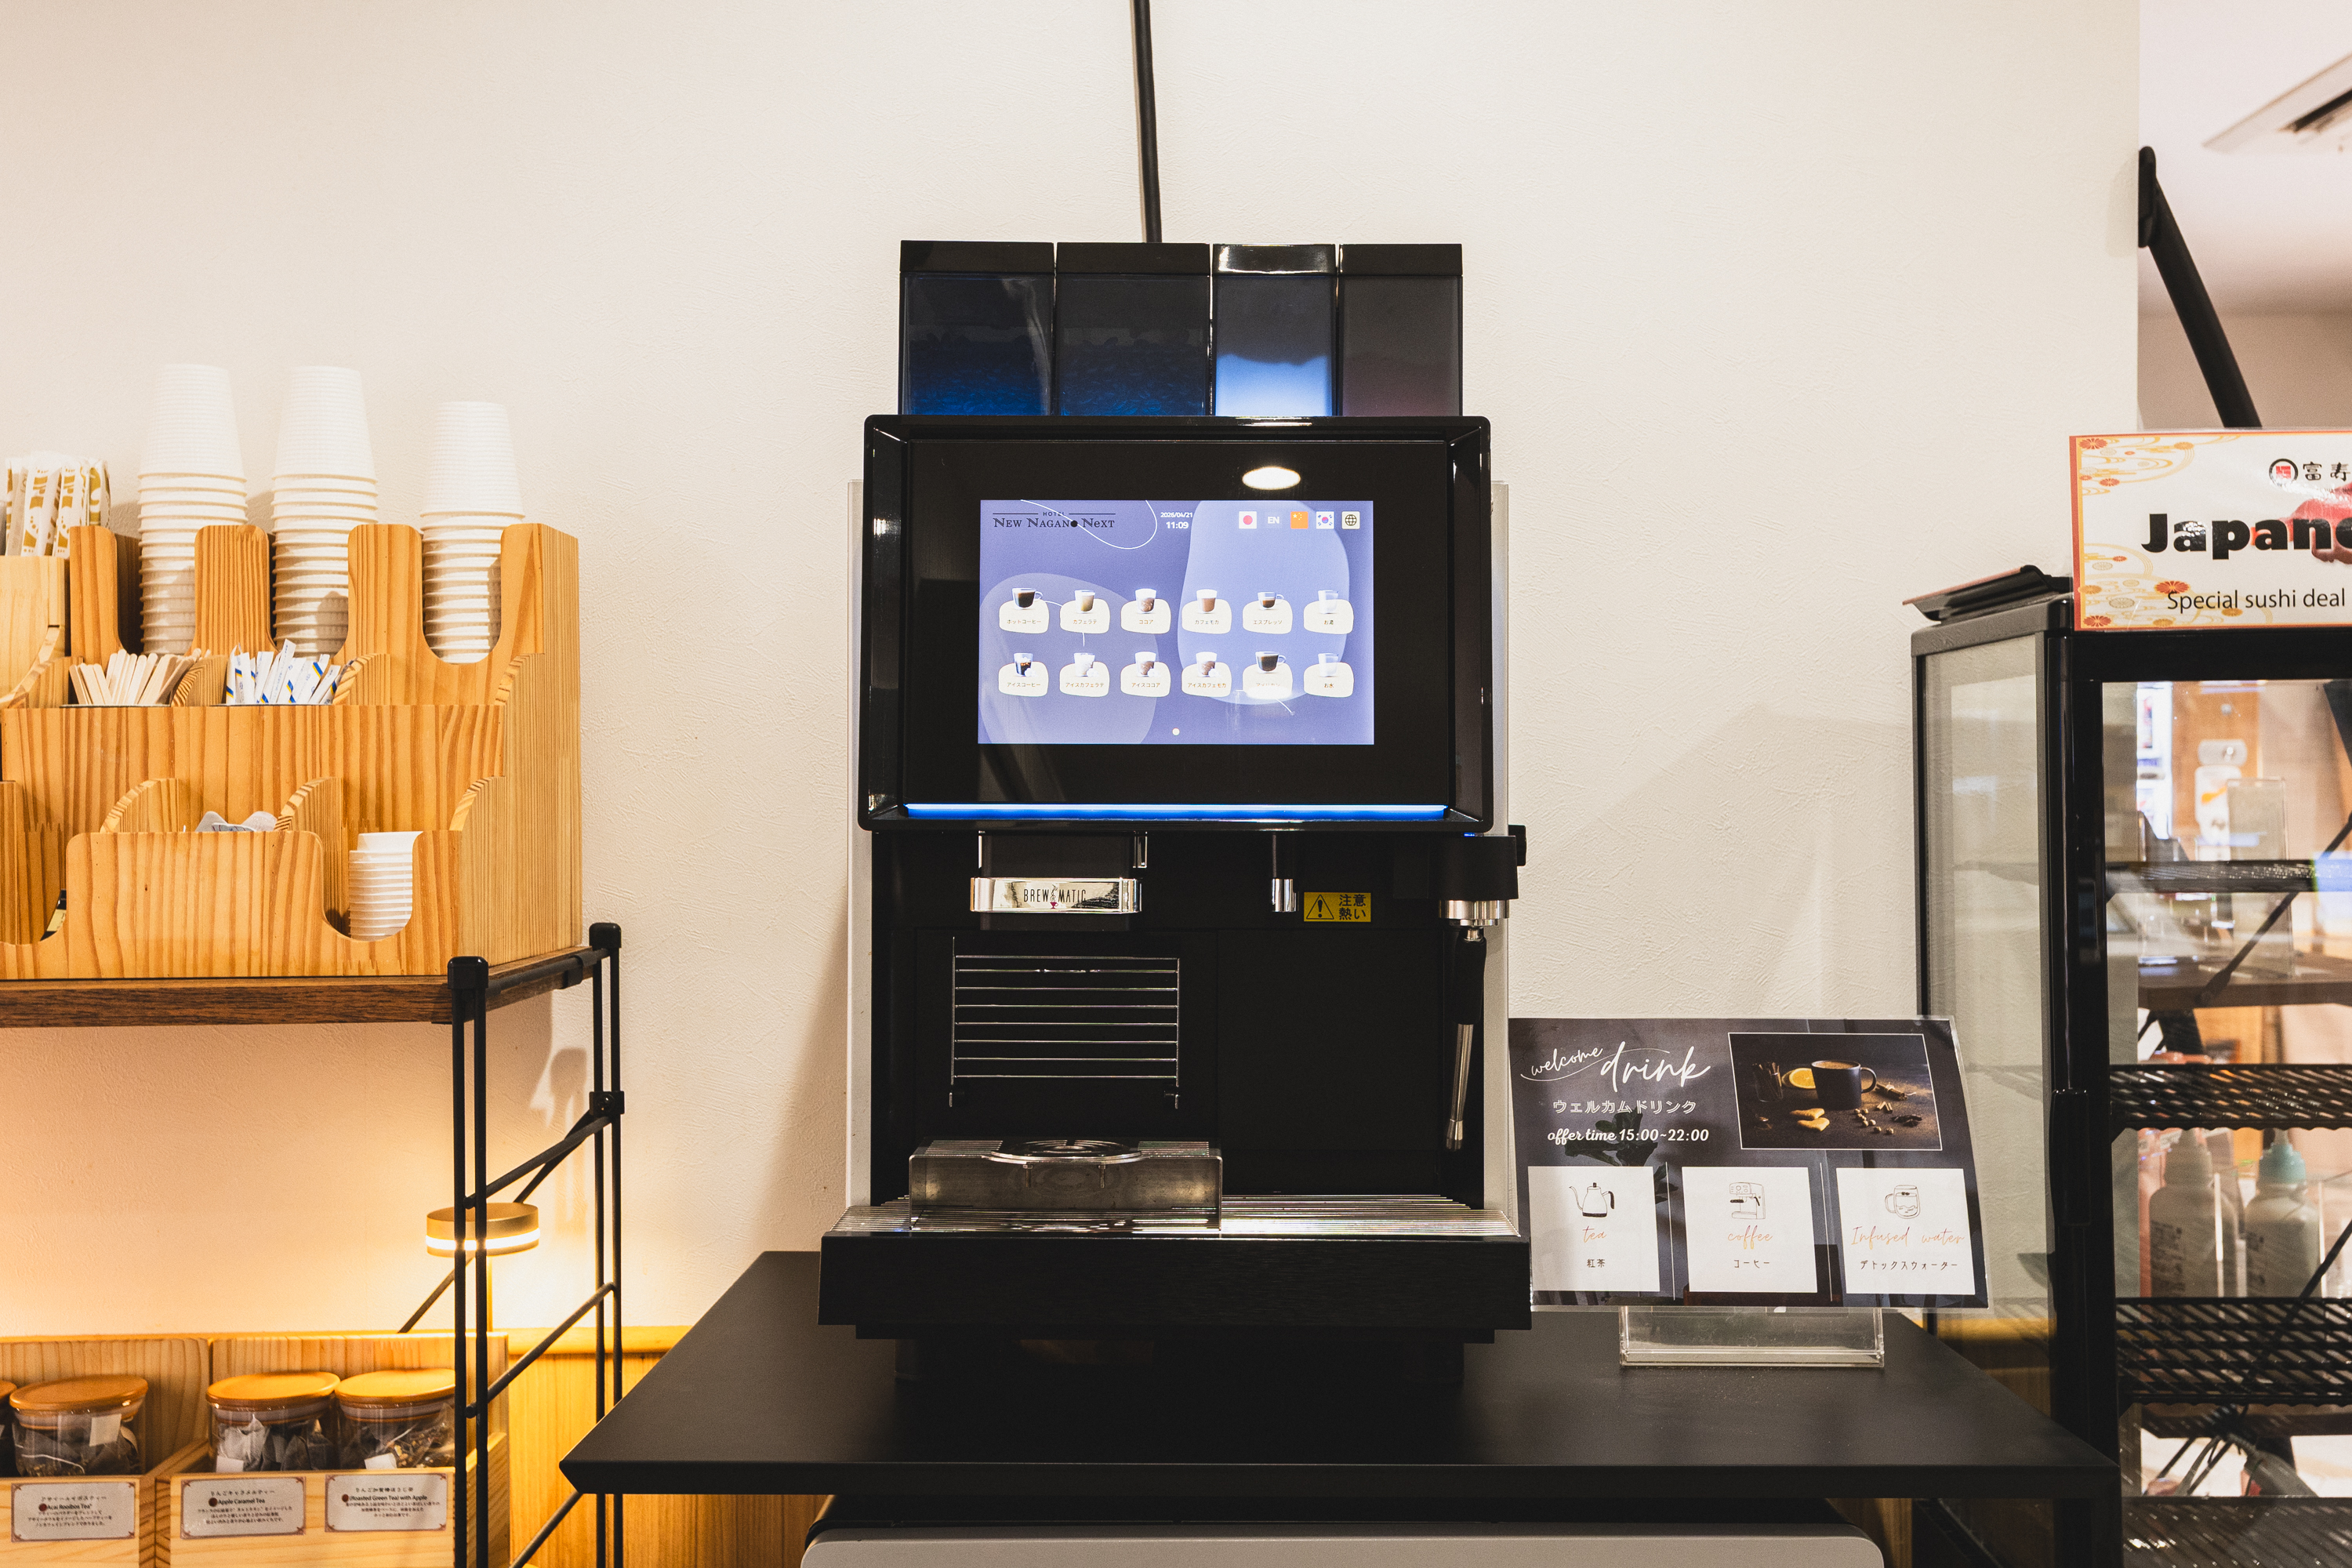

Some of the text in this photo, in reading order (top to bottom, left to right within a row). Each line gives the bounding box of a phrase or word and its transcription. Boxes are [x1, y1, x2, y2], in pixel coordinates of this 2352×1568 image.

[993, 518, 1022, 528] NEW
[2167, 588, 2345, 613] Special sushi deal
[1023, 888, 1087, 902] BREW MATIC
[1339, 894, 1367, 906] 注意
[1339, 907, 1367, 920] 熱い
[1531, 1040, 1711, 1092] welcome drink
[1552, 1099, 1697, 1115] ウェルカムドリンク
[1547, 1128, 1584, 1145] offer
[1585, 1128, 1617, 1141] time
[1582, 1225, 1607, 1243] tea
[1727, 1225, 1773, 1250] coffee
[1851, 1225, 1965, 1250] Infused water
[1586, 1258, 1606, 1269] 紅茶
[1733, 1259, 1770, 1269] コーヒー
[1860, 1260, 1958, 1271] デトックスウォーター
